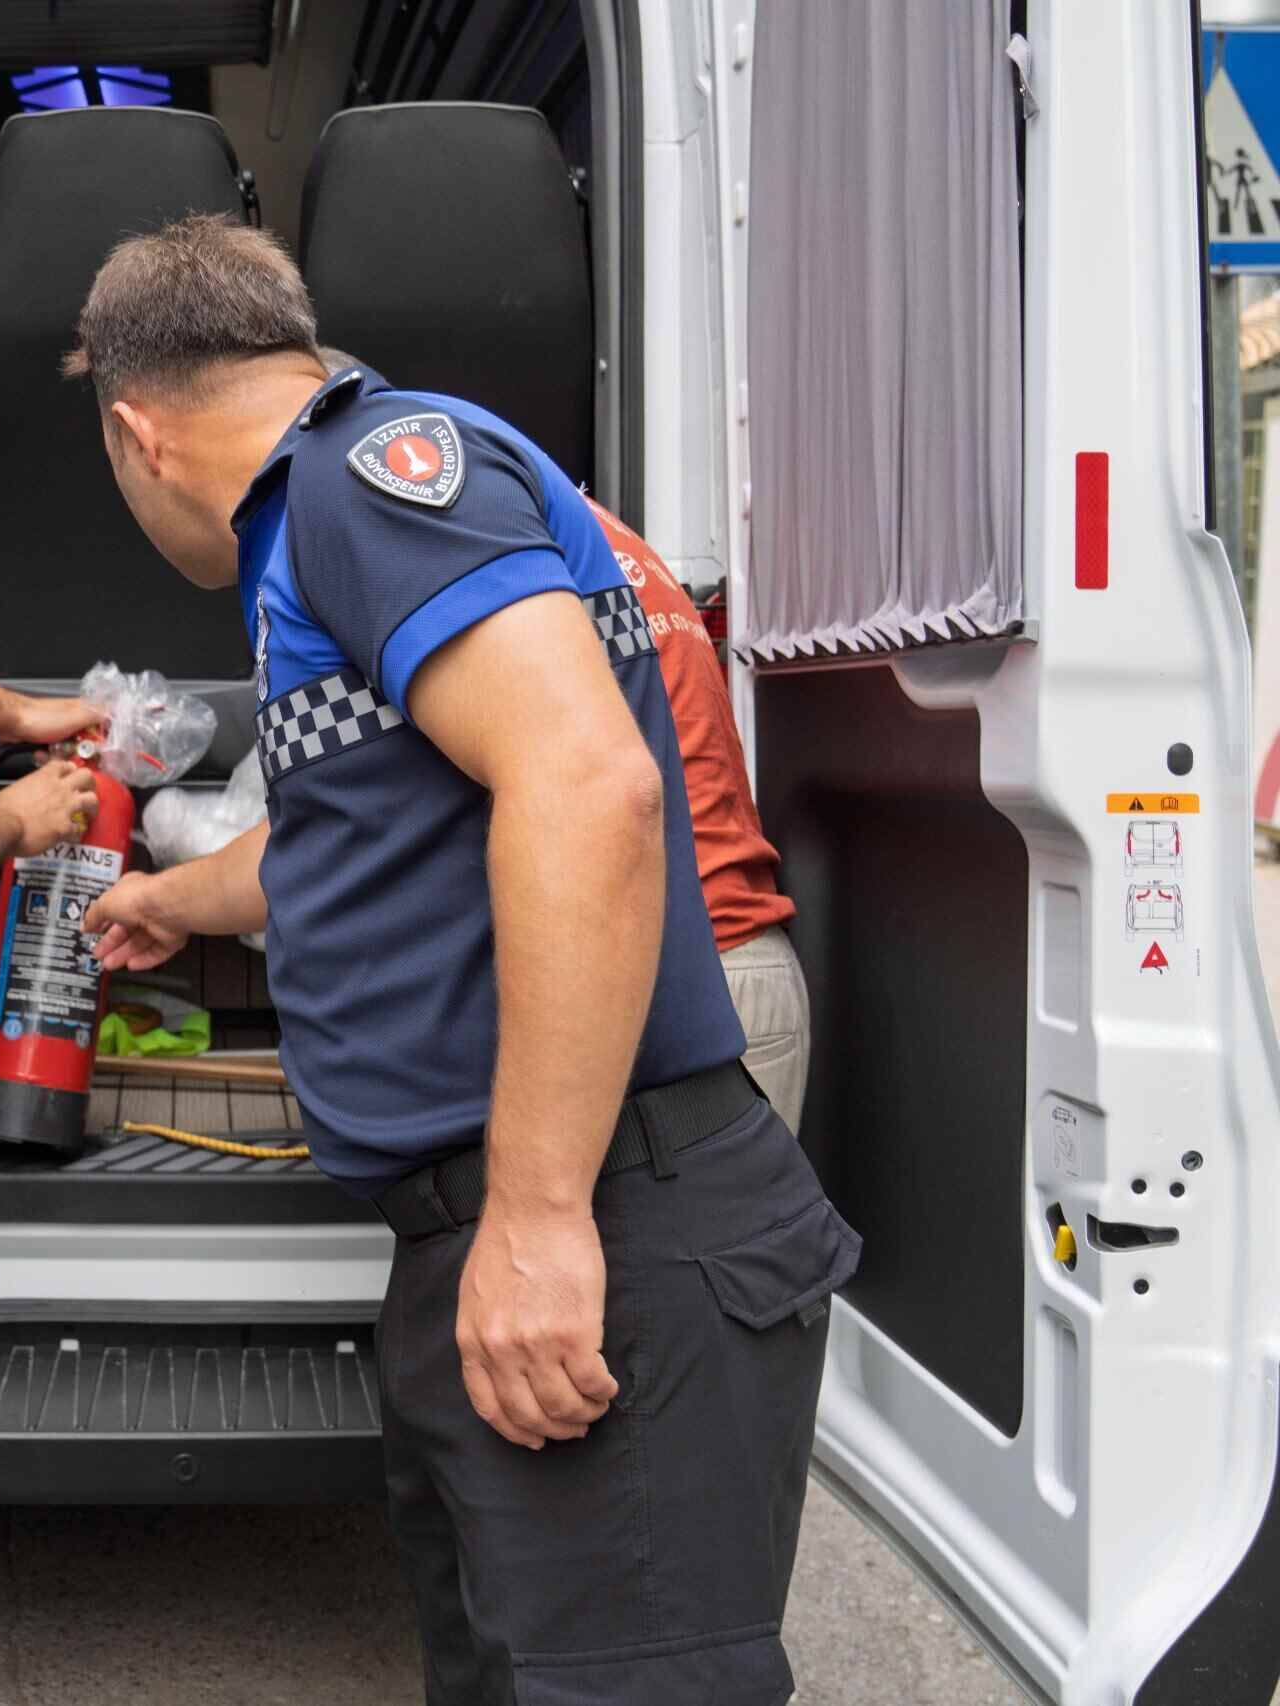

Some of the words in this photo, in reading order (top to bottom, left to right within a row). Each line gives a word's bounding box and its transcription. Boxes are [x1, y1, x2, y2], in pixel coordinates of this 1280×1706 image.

[372, 422, 421, 446] İZMİR
[363, 453, 434, 498] BÜYÜKŞEHİR
[431, 425, 456, 492] BELEDİYESİ
[43, 844, 114, 868] YANUS
